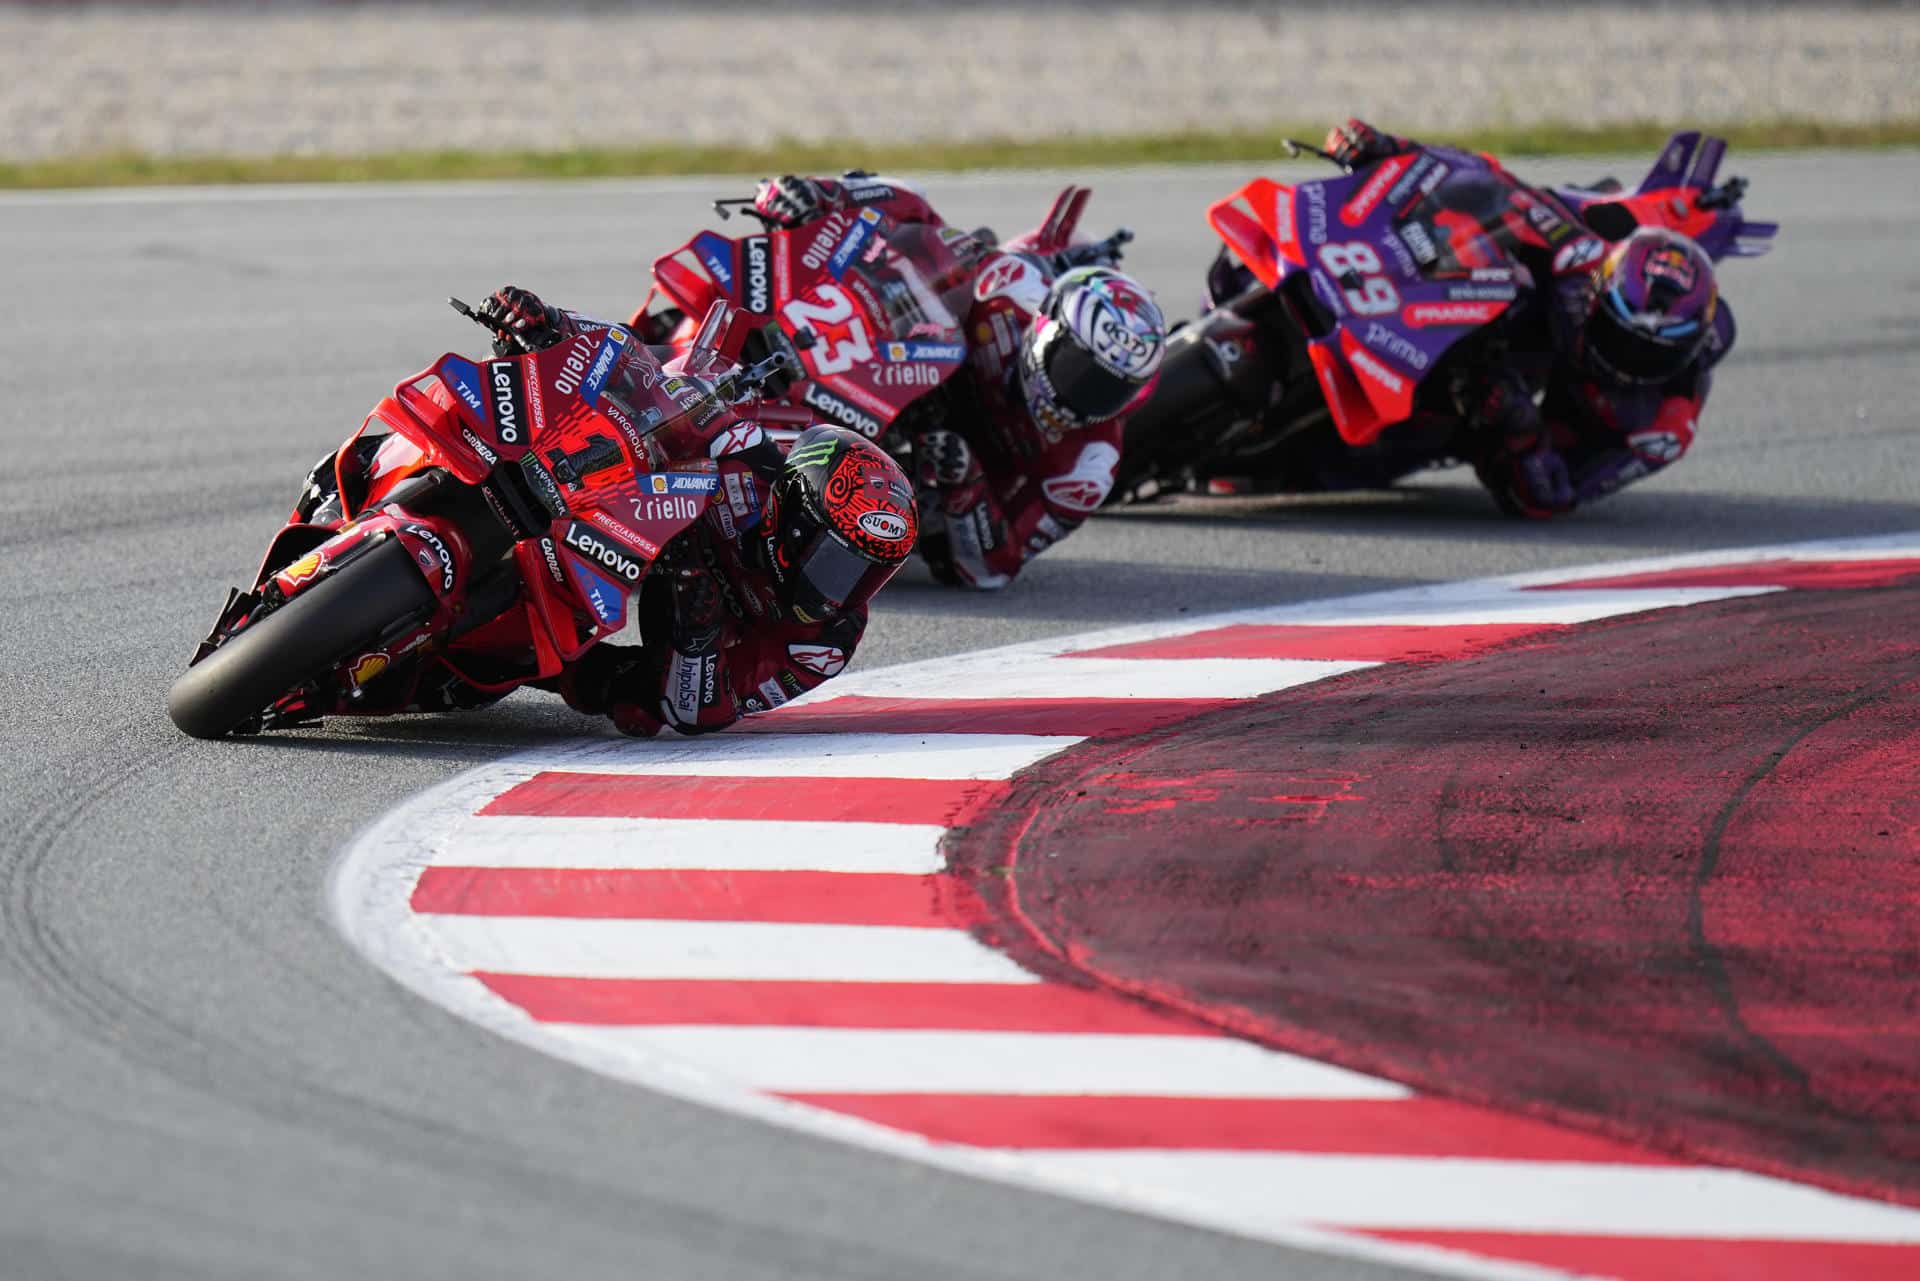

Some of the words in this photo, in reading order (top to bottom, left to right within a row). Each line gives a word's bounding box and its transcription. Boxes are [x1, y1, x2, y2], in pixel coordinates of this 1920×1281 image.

[706, 256, 731, 284] TIM
[749, 238, 768, 312] Lenovo
[1318, 241, 1401, 315] 89
[784, 284, 872, 375] 23
[456, 380, 481, 409] TIM
[492, 361, 518, 443] Lenovo
[804, 383, 880, 437] Lenovo
[463, 428, 497, 464] CARRERA
[607, 405, 645, 460] VARGROUP
[546, 433, 625, 491] 1
[671, 477, 717, 491] ADVANCE
[533, 463, 567, 516] MONSTER
[406, 525, 453, 590] Lenovo
[565, 523, 640, 580] Lenovo
[592, 512, 657, 554] FRECCIAROSSA
[767, 536, 783, 583] Lenovo
[590, 589, 609, 619] TIM
[676, 656, 698, 712] UnipolSai
[703, 654, 717, 704] Lenovo
